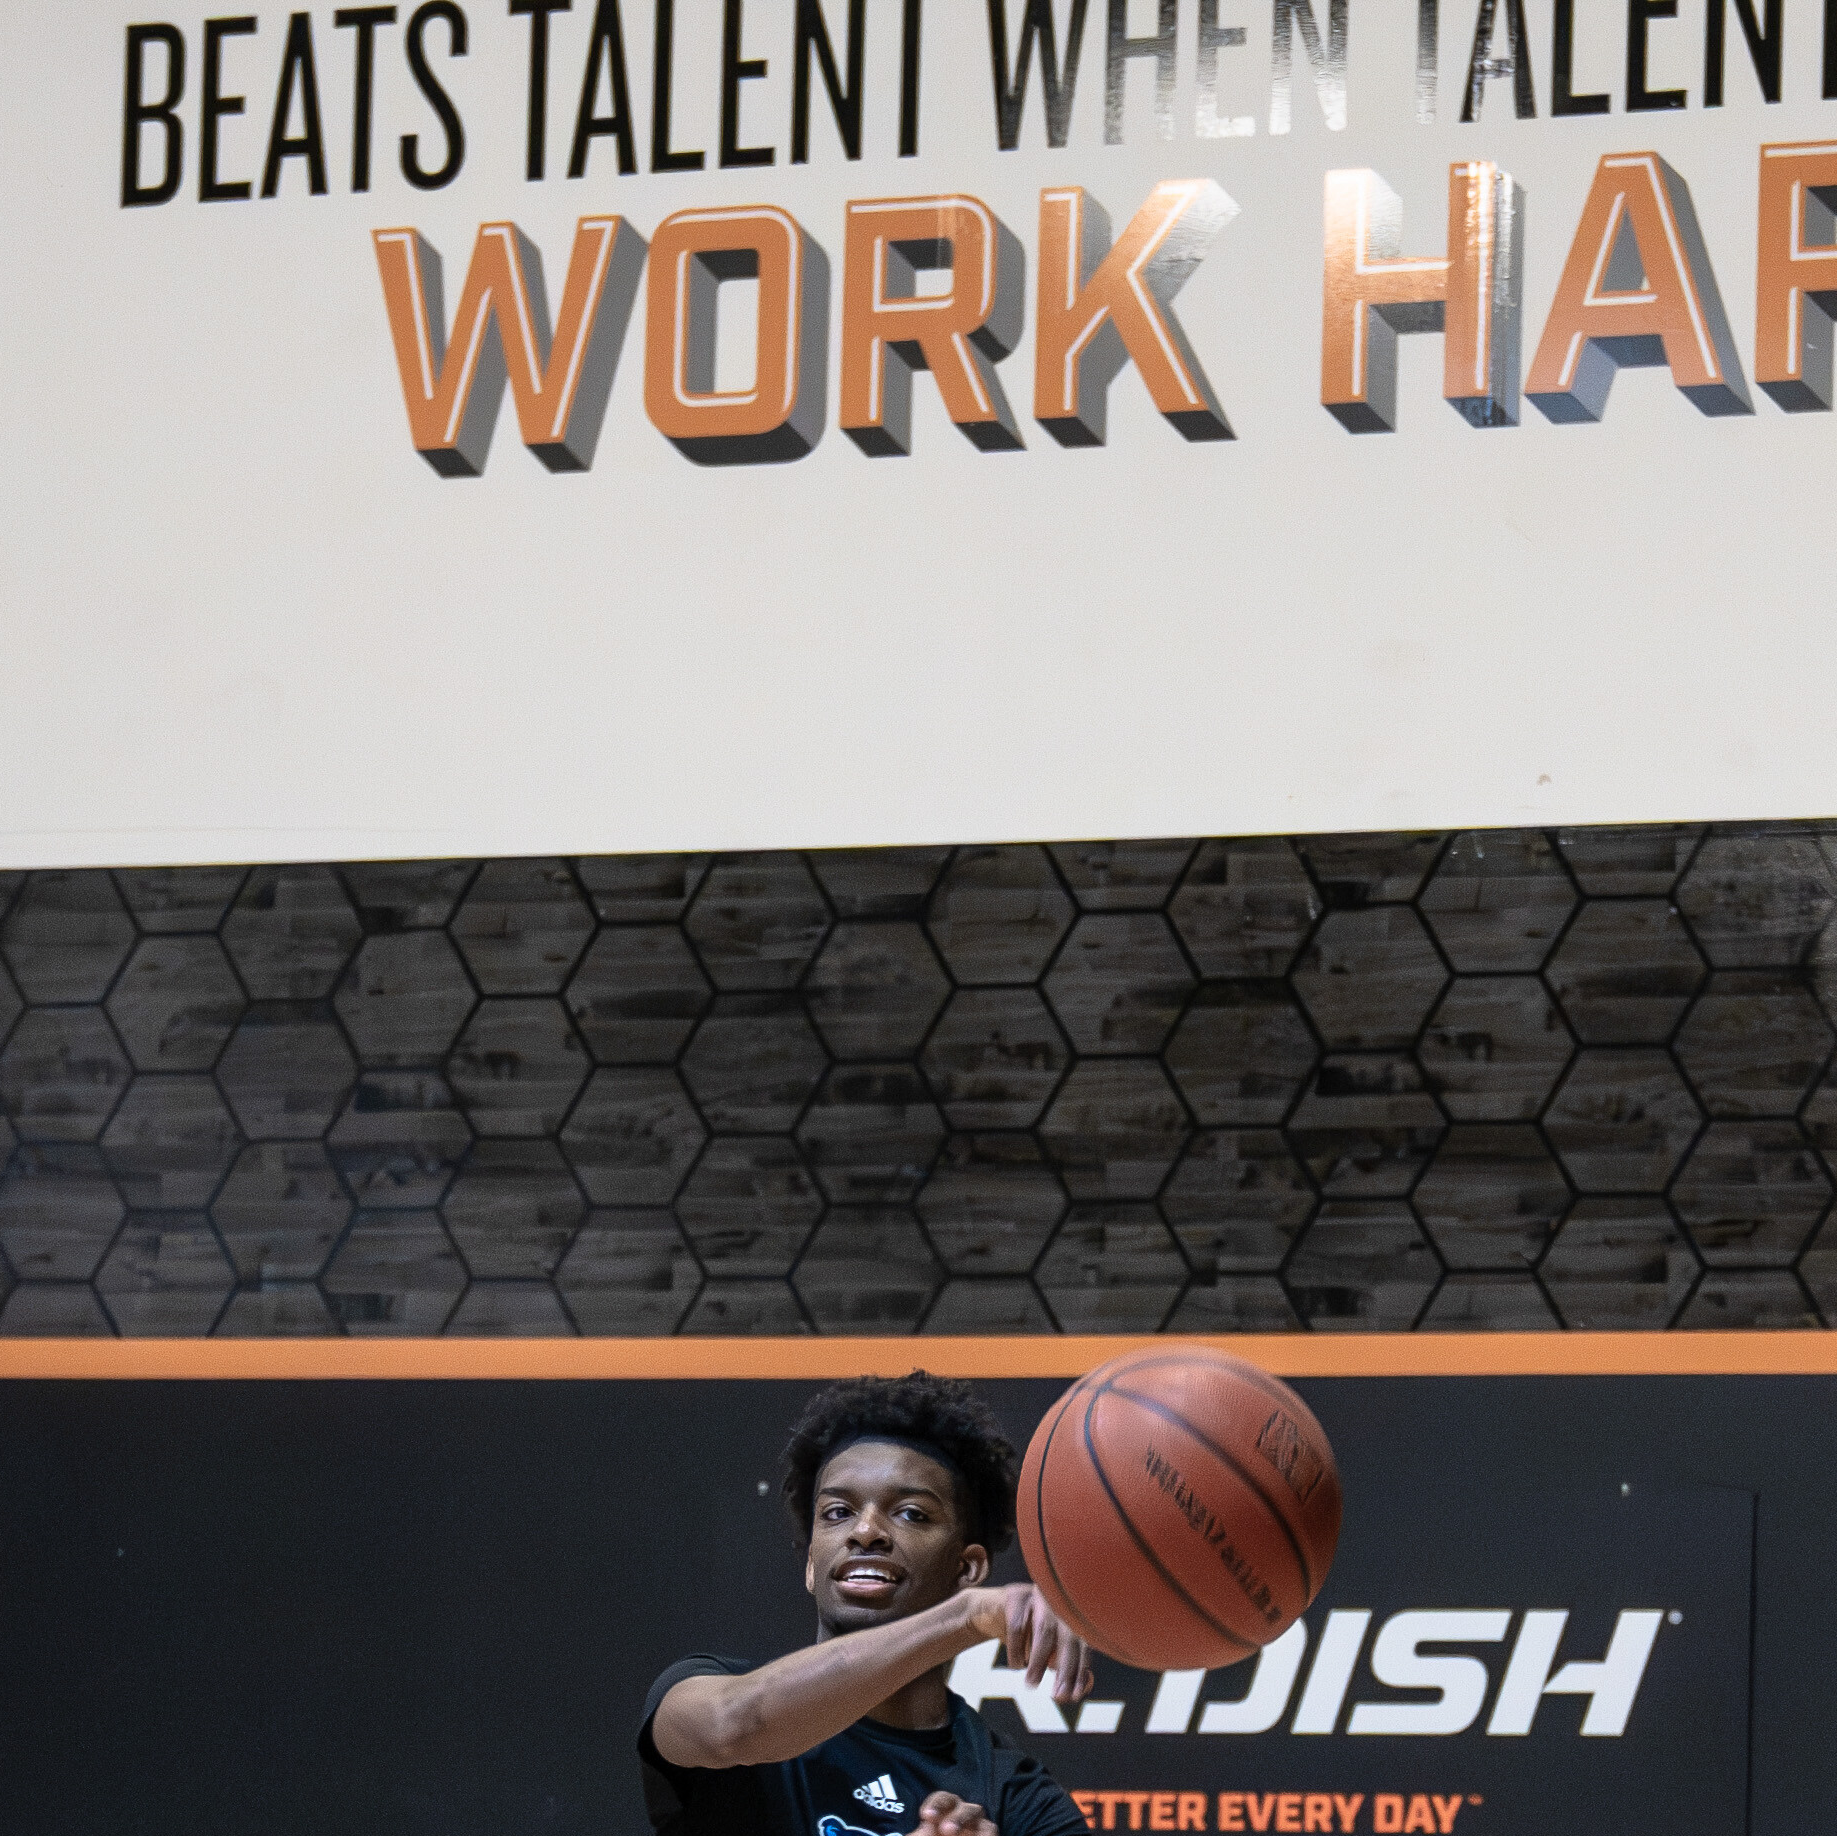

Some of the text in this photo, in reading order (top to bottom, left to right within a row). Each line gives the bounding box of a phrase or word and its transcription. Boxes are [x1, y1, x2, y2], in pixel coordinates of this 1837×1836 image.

[120, 0, 470, 209] BEATS
[508, 0, 923, 183] TALENT
[988, 0, 1350, 151] WHEN
[370, 178, 1240, 478] WORK
[852, 1788, 906, 1814] adidas
[1069, 1789, 1464, 1835] ETTER EVERY DAY
